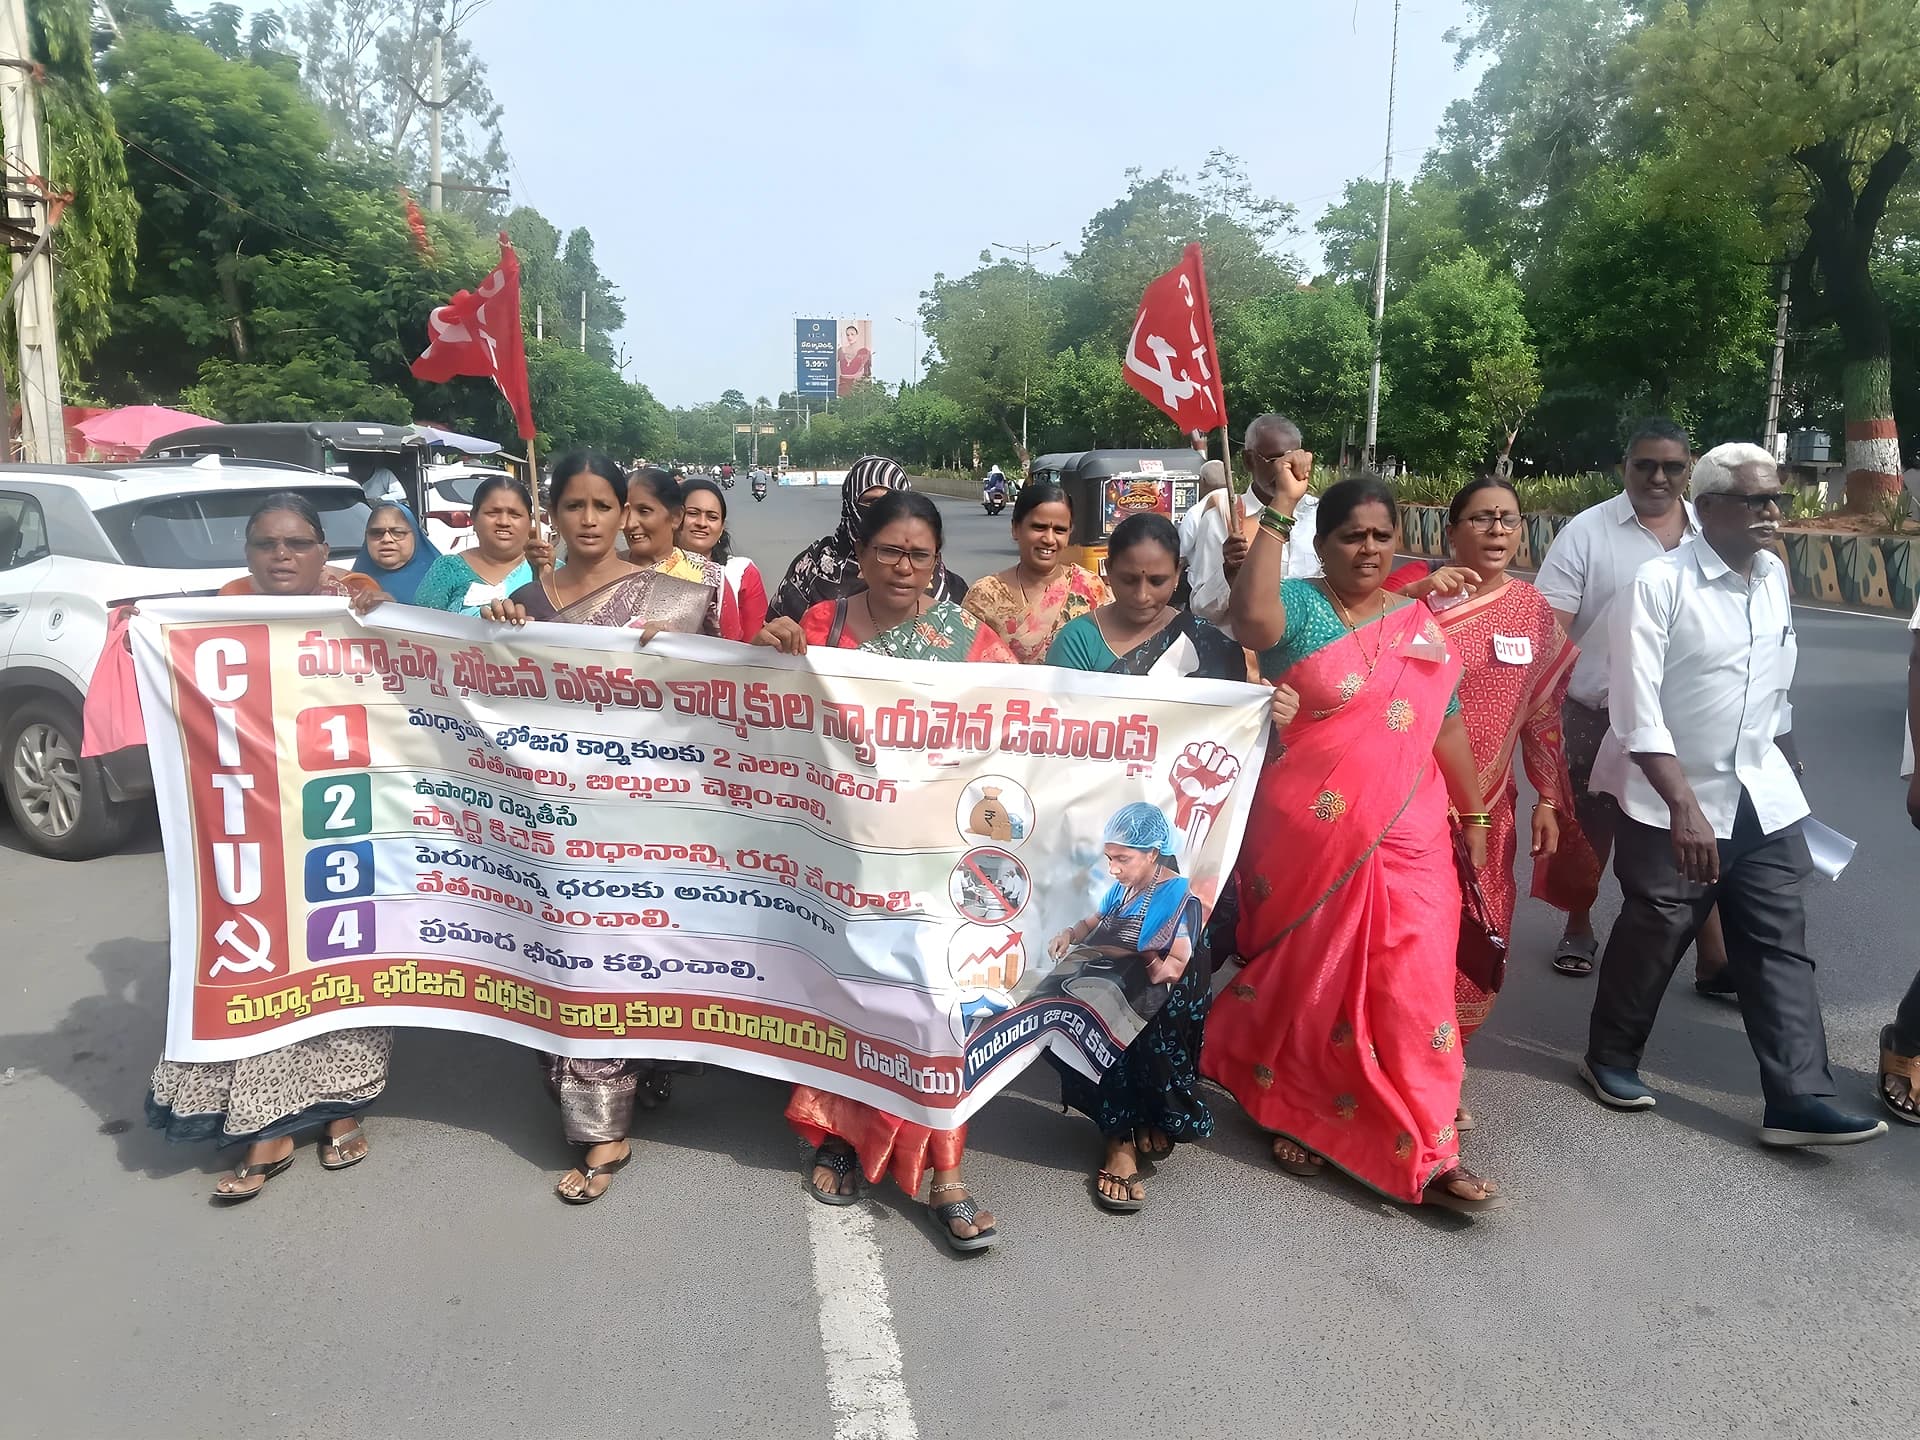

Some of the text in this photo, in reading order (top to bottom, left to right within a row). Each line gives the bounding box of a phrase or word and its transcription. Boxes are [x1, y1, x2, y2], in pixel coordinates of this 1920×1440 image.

[1495, 640, 1526, 658] CITU
[297, 630, 449, 698] మధ్యాహ్న
[450, 646, 548, 700] భోజన
[665, 678, 815, 741] కార్మికుల
[821, 698, 992, 768] న్యాయమైన
[999, 699, 1160, 778] డిమాండ్లు
[320, 715, 350, 761] 1
[407, 707, 898, 804] మధ్యాహ్న భోజన కార్మికులకు 2 నెలల పెండింగ్
[194, 637, 263, 906] CITU
[413, 777, 578, 828] ఉపాధిని దెబ్బతీసే
[467, 747, 832, 825] వేతనాలు, బిల్లులు చెల్లించాలి.
[323, 784, 356, 830] 2
[325, 850, 360, 893] 3
[413, 803, 924, 913] స్మార్ట్ కిచెన్ విధానాన్ని రద్దు చేయాలి.
[415, 845, 836, 936] పెరుగుతున్న ధరలకు అనుగుణంగా
[327, 909, 363, 950] 4
[416, 870, 681, 930] వేతనాలు పెంచాలి.
[419, 918, 766, 981] ప్రమాద భీమా కల్పించాలి.
[225, 971, 365, 1025] మధ్యాహ్న
[372, 960, 467, 999] భోజన
[473, 973, 552, 1021] పథకం
[558, 1000, 684, 1037] కార్మికుల
[690, 1003, 848, 1062] యూనియన్
[967, 1014, 1040, 1077] గుంటూరు
[1042, 1008, 1087, 1042] జిల్లా
